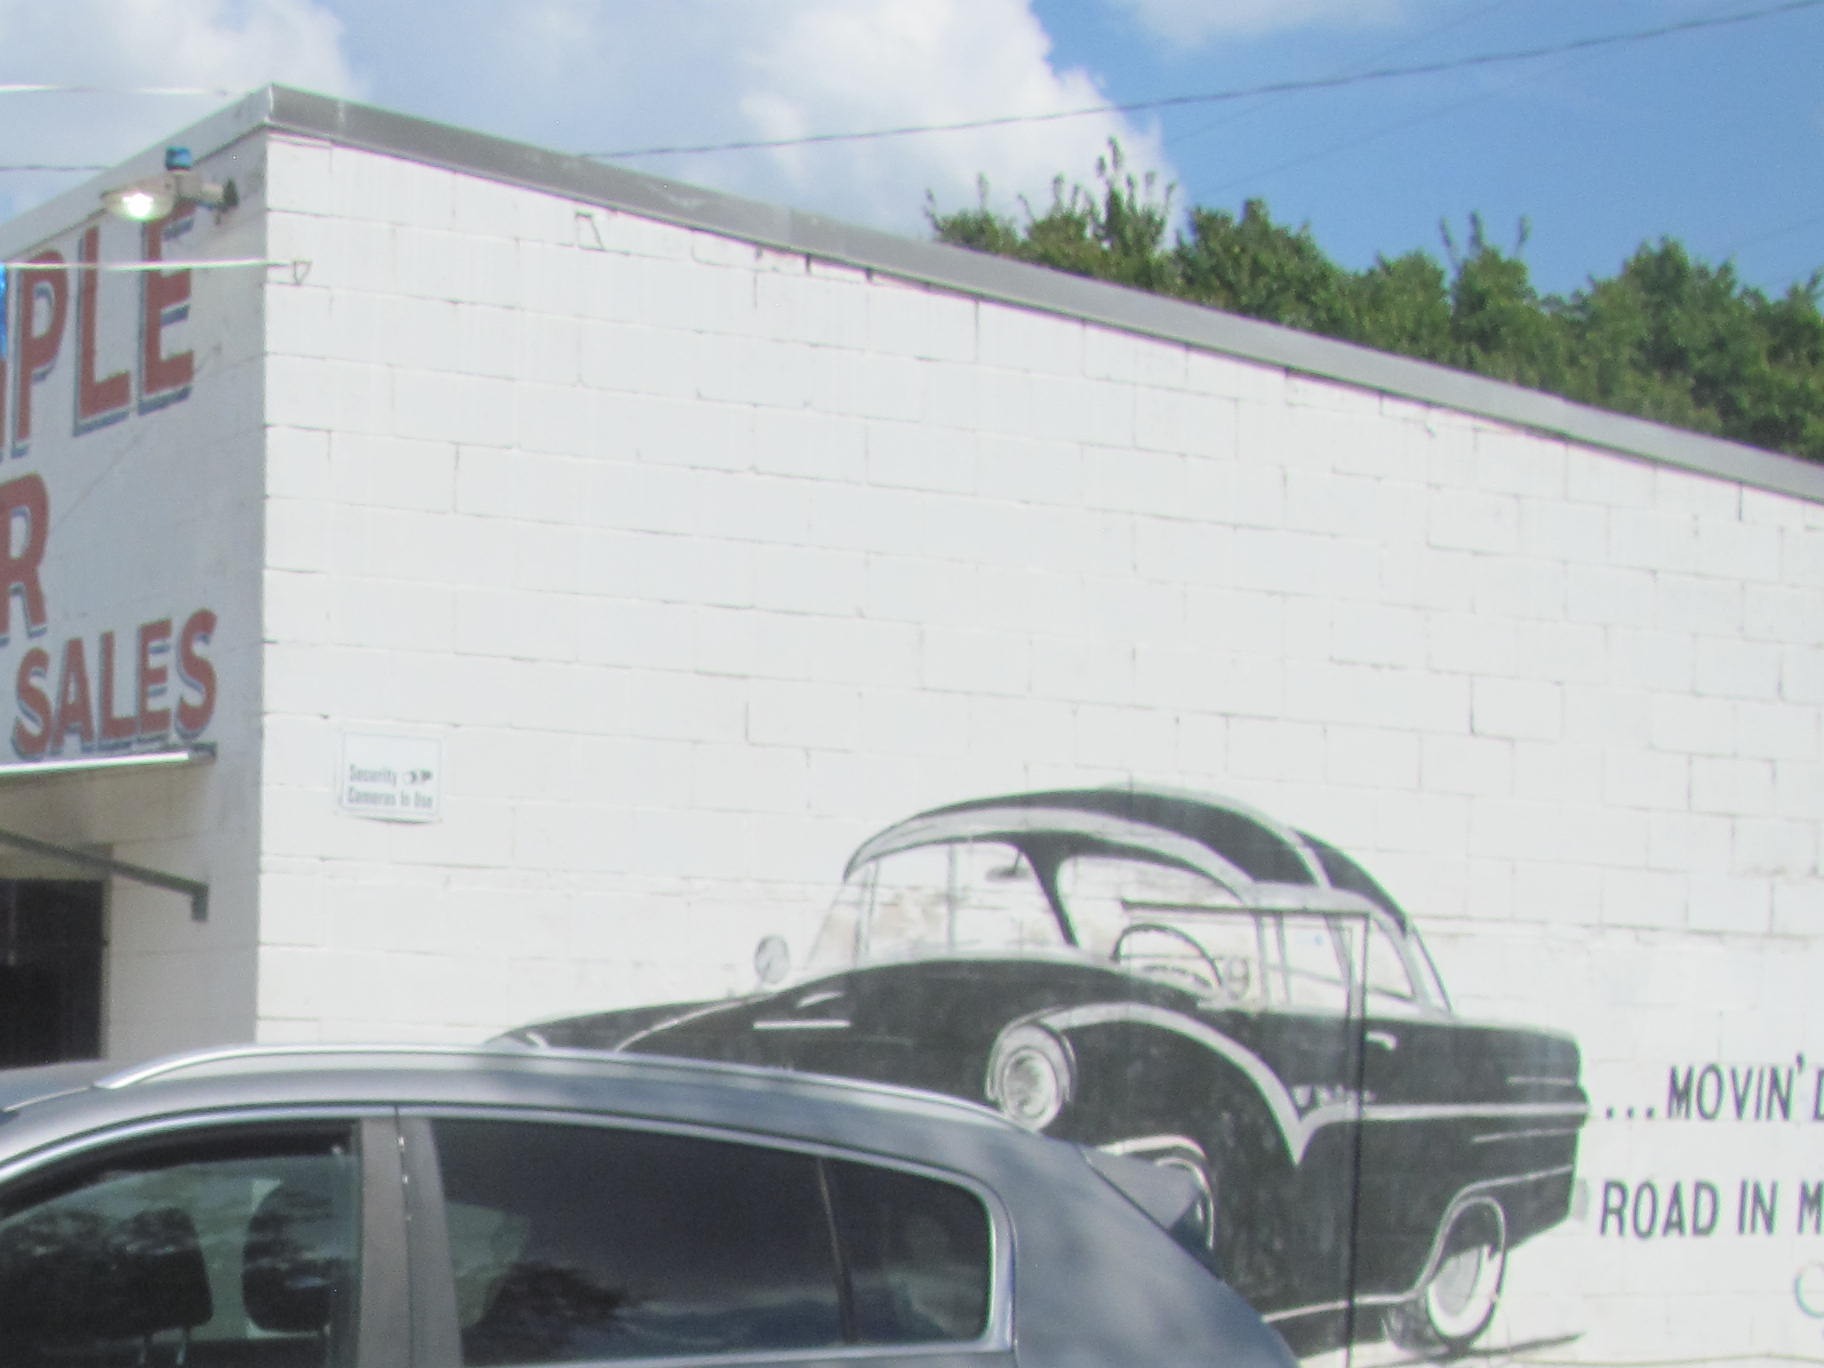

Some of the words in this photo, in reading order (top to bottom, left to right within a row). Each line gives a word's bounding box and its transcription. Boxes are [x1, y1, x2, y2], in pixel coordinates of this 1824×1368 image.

[10, 608, 218, 760] SALES
[1599, 1178, 1721, 1239] ROAD
[1736, 1177, 1780, 1236] IN
